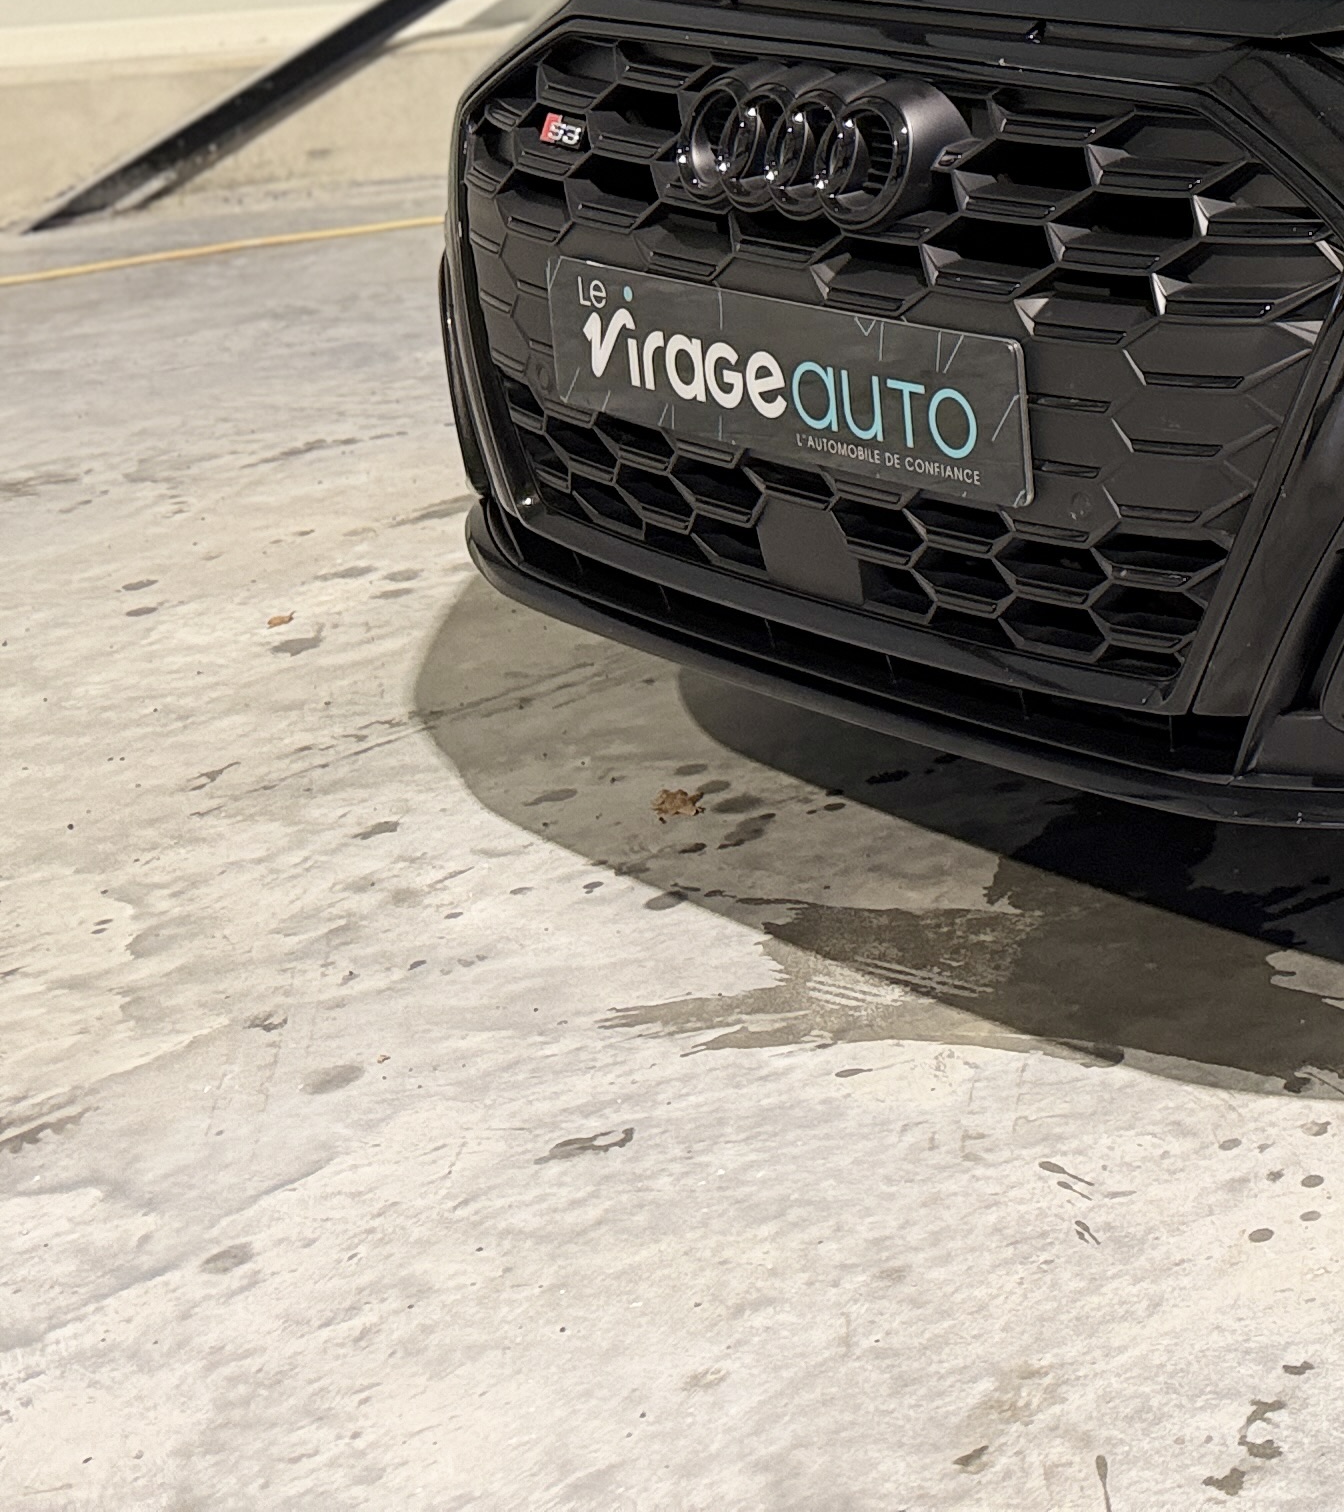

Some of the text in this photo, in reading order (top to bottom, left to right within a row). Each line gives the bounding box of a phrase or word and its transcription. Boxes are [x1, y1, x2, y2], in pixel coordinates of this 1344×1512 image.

[547, 121, 582, 145] S3
[577, 275, 608, 309] Le
[795, 433, 982, 486] L'AUTOMOBILE DE CONFIANCE
